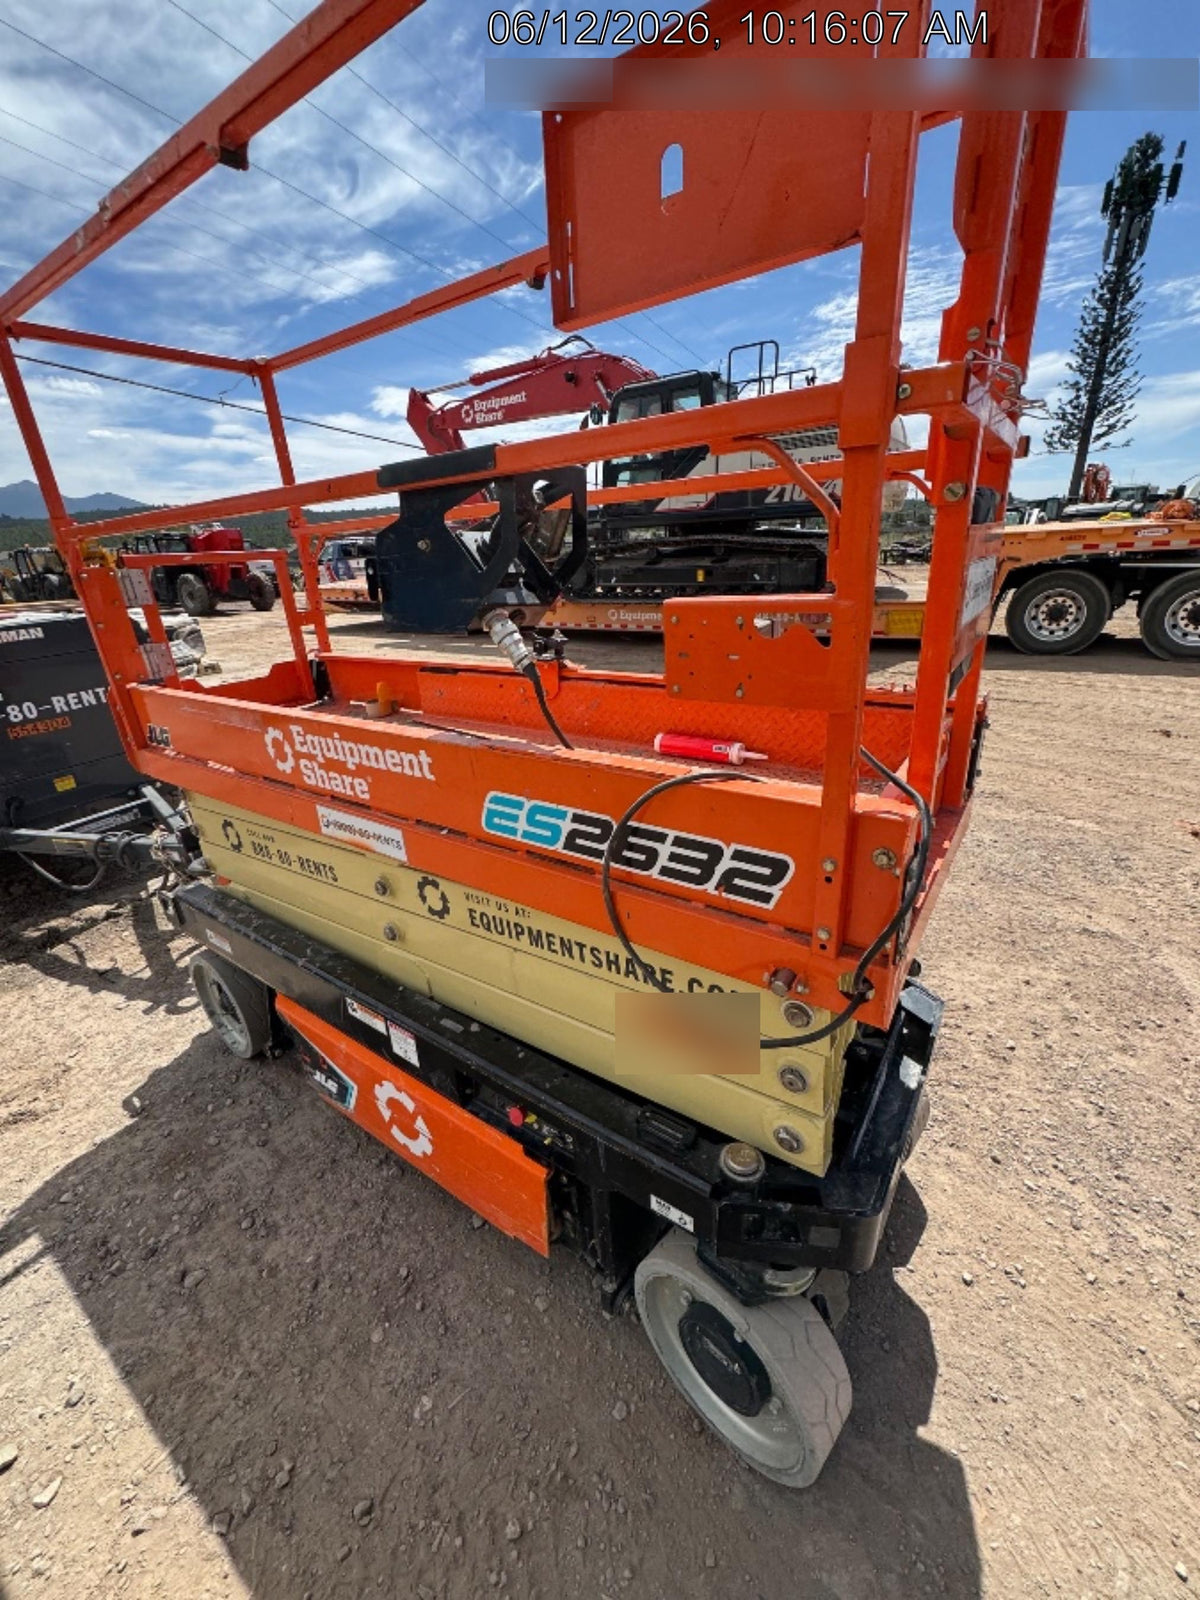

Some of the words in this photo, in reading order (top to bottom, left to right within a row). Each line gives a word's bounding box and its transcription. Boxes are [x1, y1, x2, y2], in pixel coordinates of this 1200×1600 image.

[473, 389, 528, 412] Equipment
[475, 410, 504, 424] Share
[0, 627, 45, 643] MAN
[0, 686, 111, 723] -80-RENT
[289, 724, 436, 781] Equipment
[300, 758, 371, 800] Share
[481, 791, 796, 910] ES2632
[463, 891, 492, 906] VISIT
[496, 900, 510, 914] US
[515, 907, 531, 919] AT:
